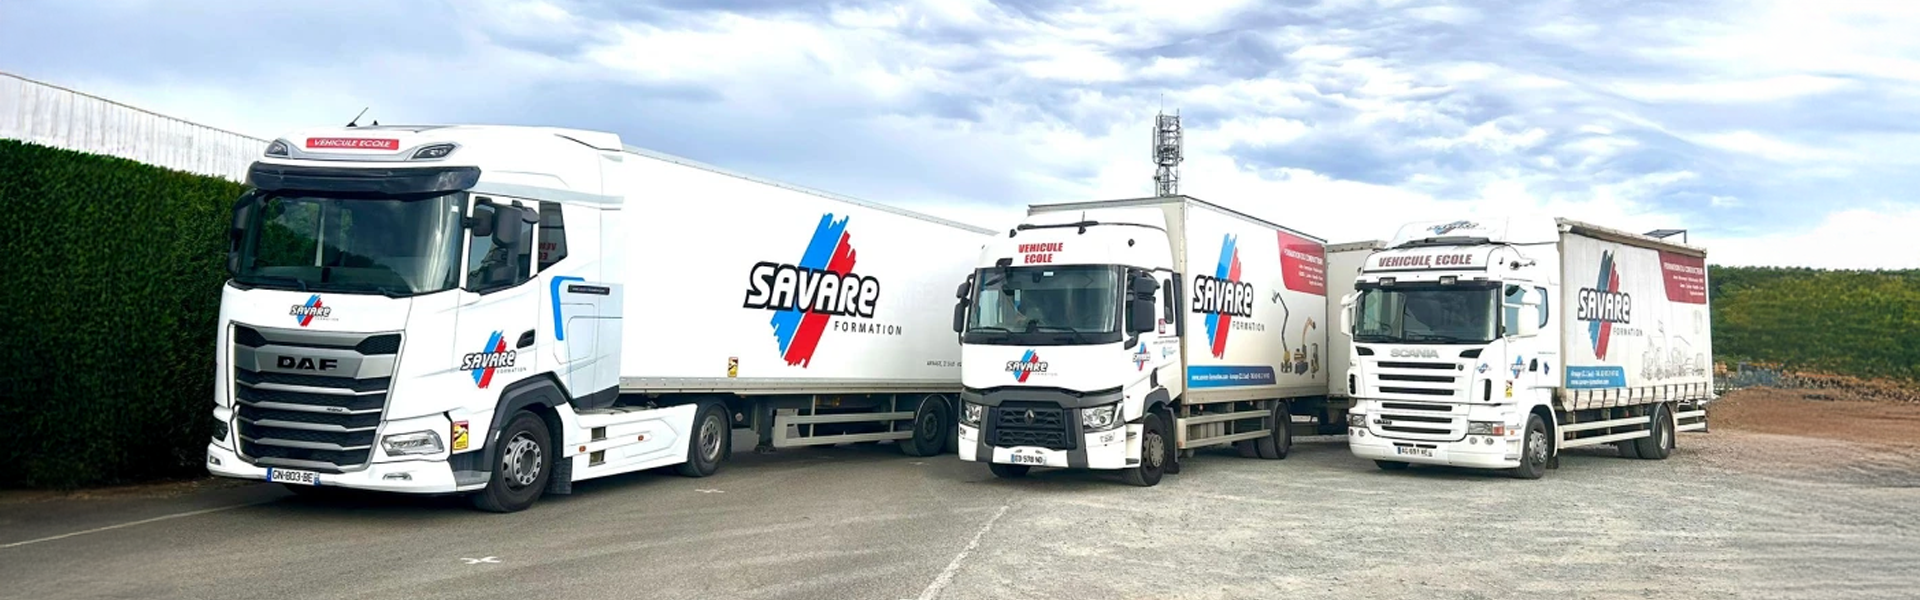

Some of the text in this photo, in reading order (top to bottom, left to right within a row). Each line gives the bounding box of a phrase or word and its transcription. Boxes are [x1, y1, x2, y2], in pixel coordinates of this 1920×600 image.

[314, 139, 391, 148] VEHICULE ECOLE
[1018, 243, 1063, 253] VEHICULE
[1024, 253, 1053, 264] ECOLE
[1378, 254, 1473, 267] VEHICULE ECOLE
[834, 320, 902, 336] FORMATION
[1390, 348, 1439, 359] SCANIA
[277, 355, 338, 371] DAF
